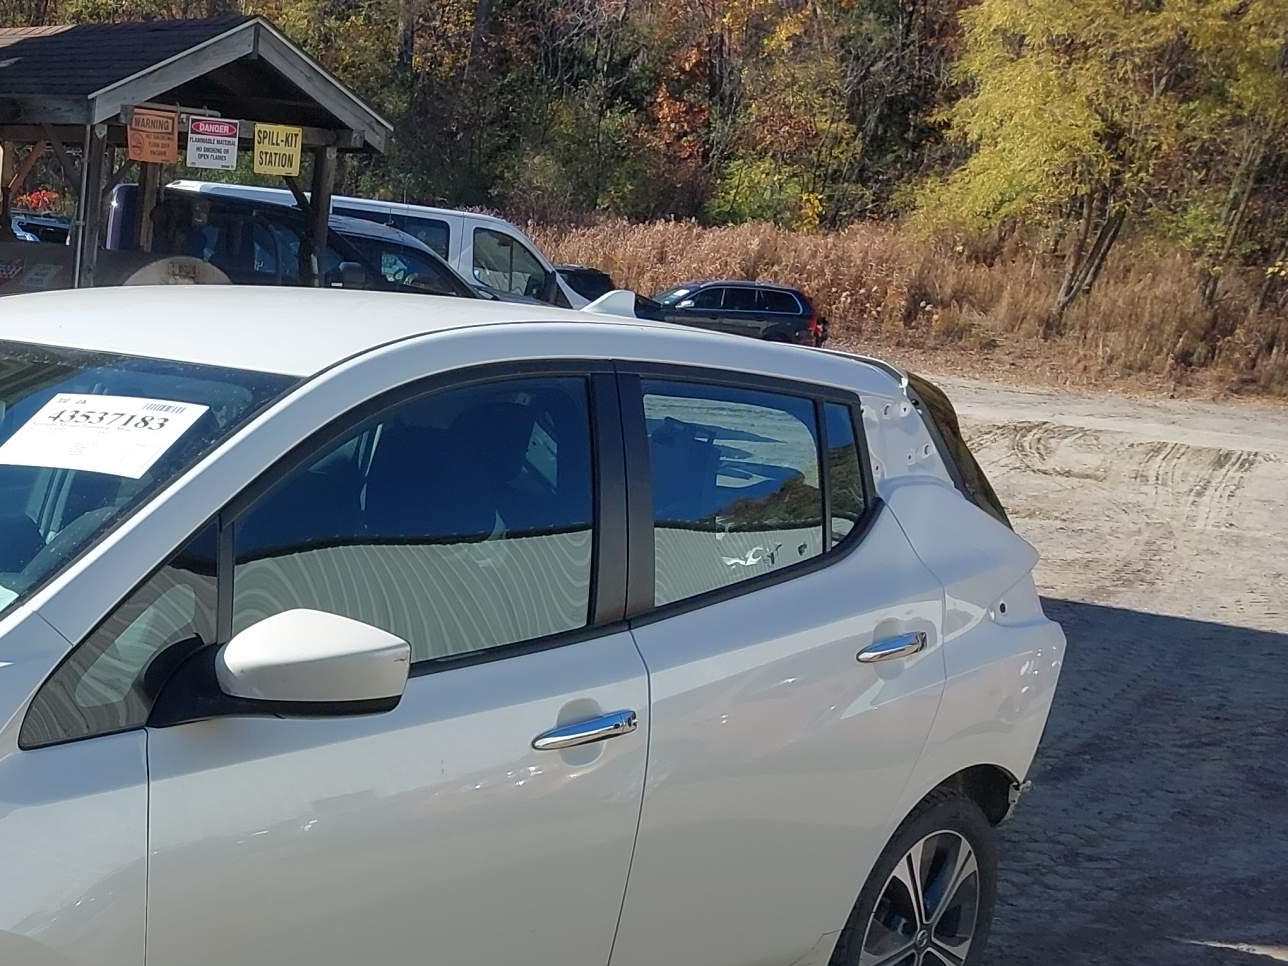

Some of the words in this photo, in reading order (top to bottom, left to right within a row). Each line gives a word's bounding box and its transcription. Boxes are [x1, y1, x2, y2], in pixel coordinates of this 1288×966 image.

[134, 116, 169, 131] WARNING
[199, 123, 229, 133] DANGER
[257, 129, 299, 148] SPILL-KIT
[259, 151, 294, 168] STATION
[47, 409, 169, 431] 43537183
